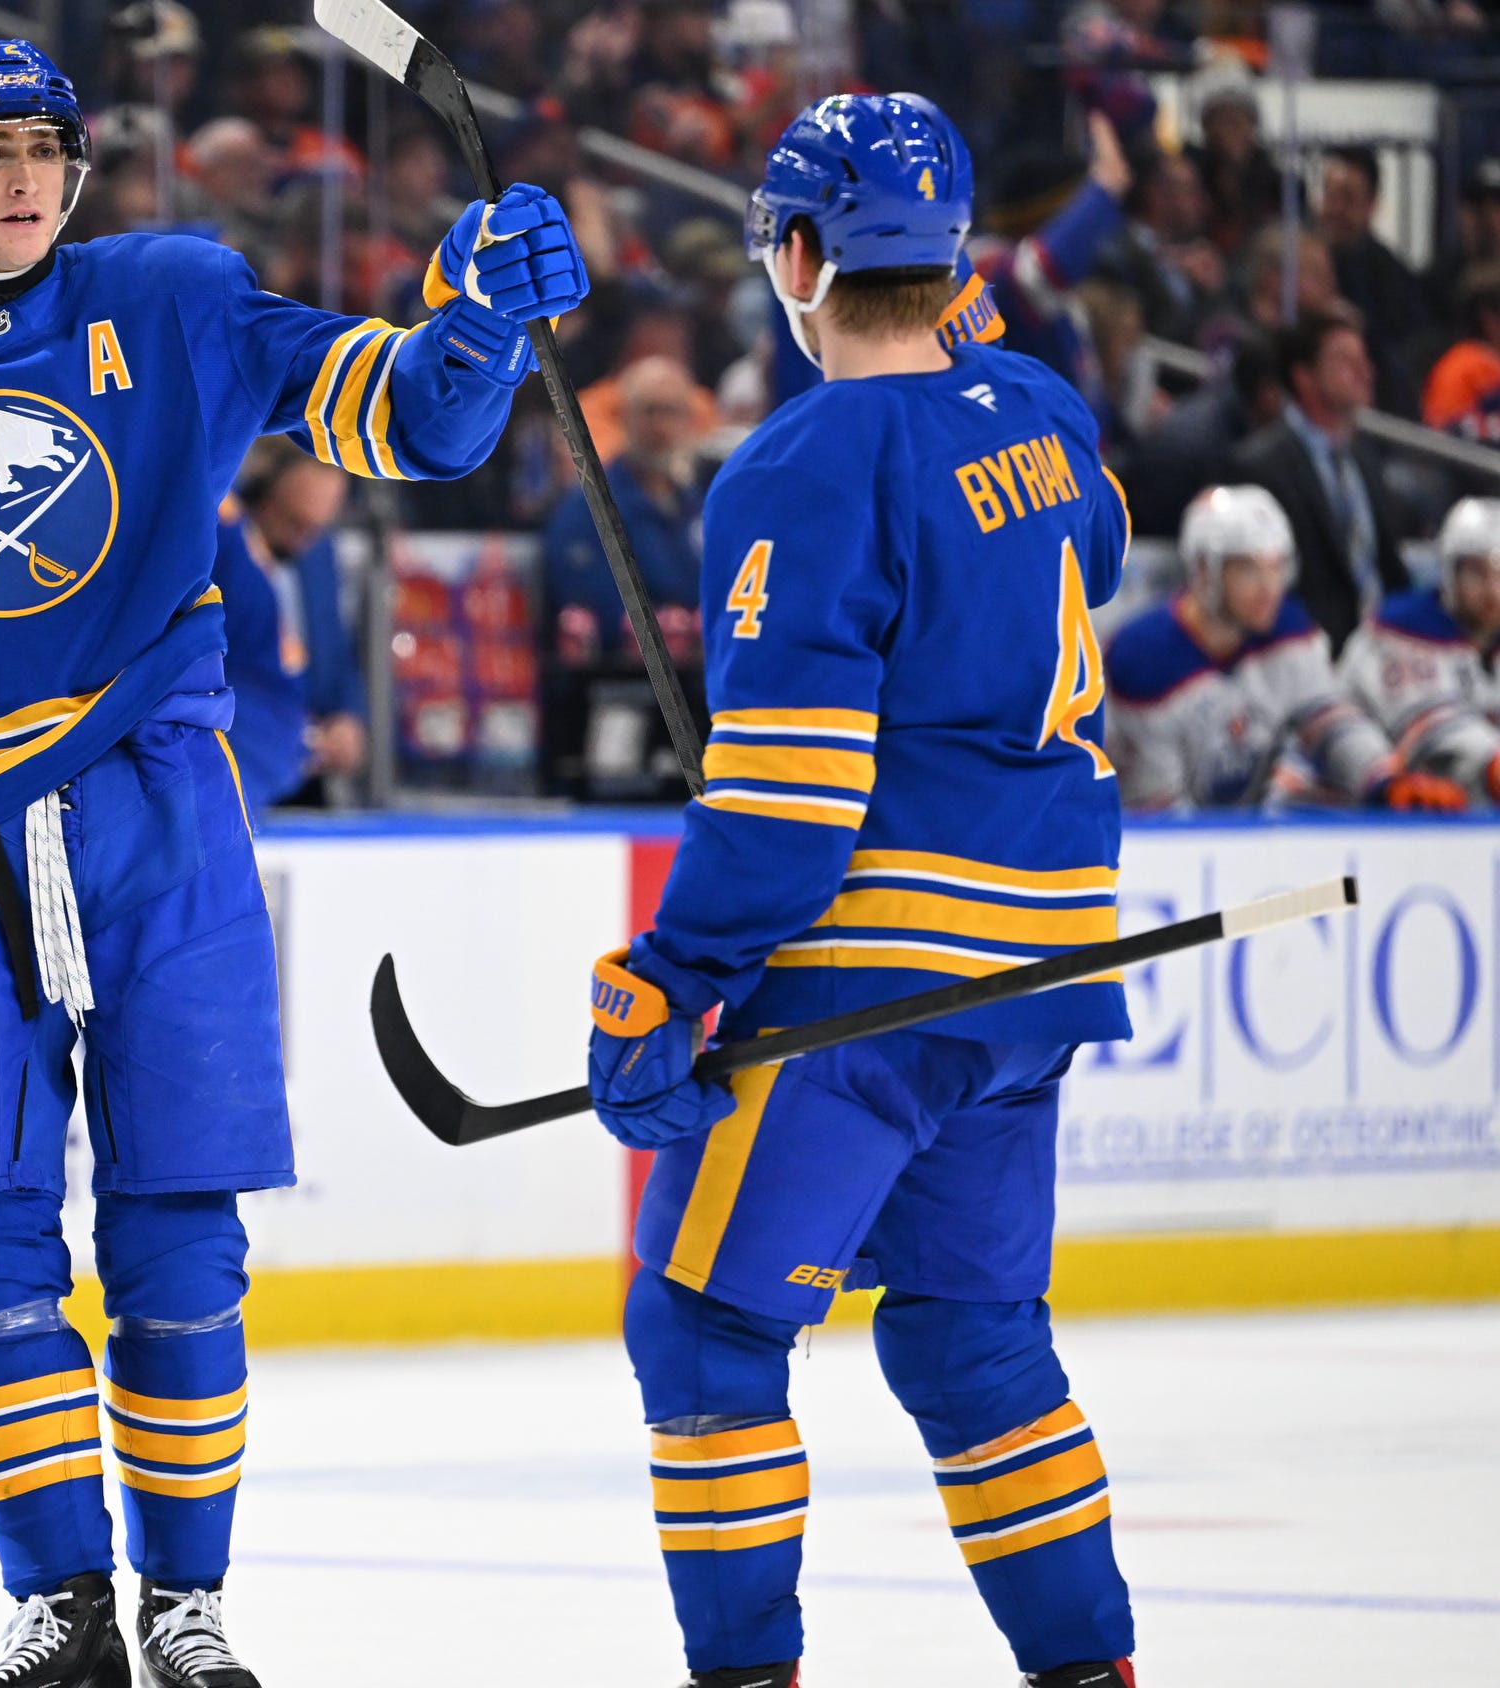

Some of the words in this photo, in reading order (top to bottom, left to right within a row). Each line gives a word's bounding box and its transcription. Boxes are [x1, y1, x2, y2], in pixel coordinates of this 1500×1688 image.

[917, 167, 936, 200] 4
[87, 319, 133, 396] A
[508, 335, 526, 372] THOMPSON
[955, 434, 1080, 533] BYRAM
[726, 540, 773, 639] 4
[1037, 536, 1117, 780] 4
